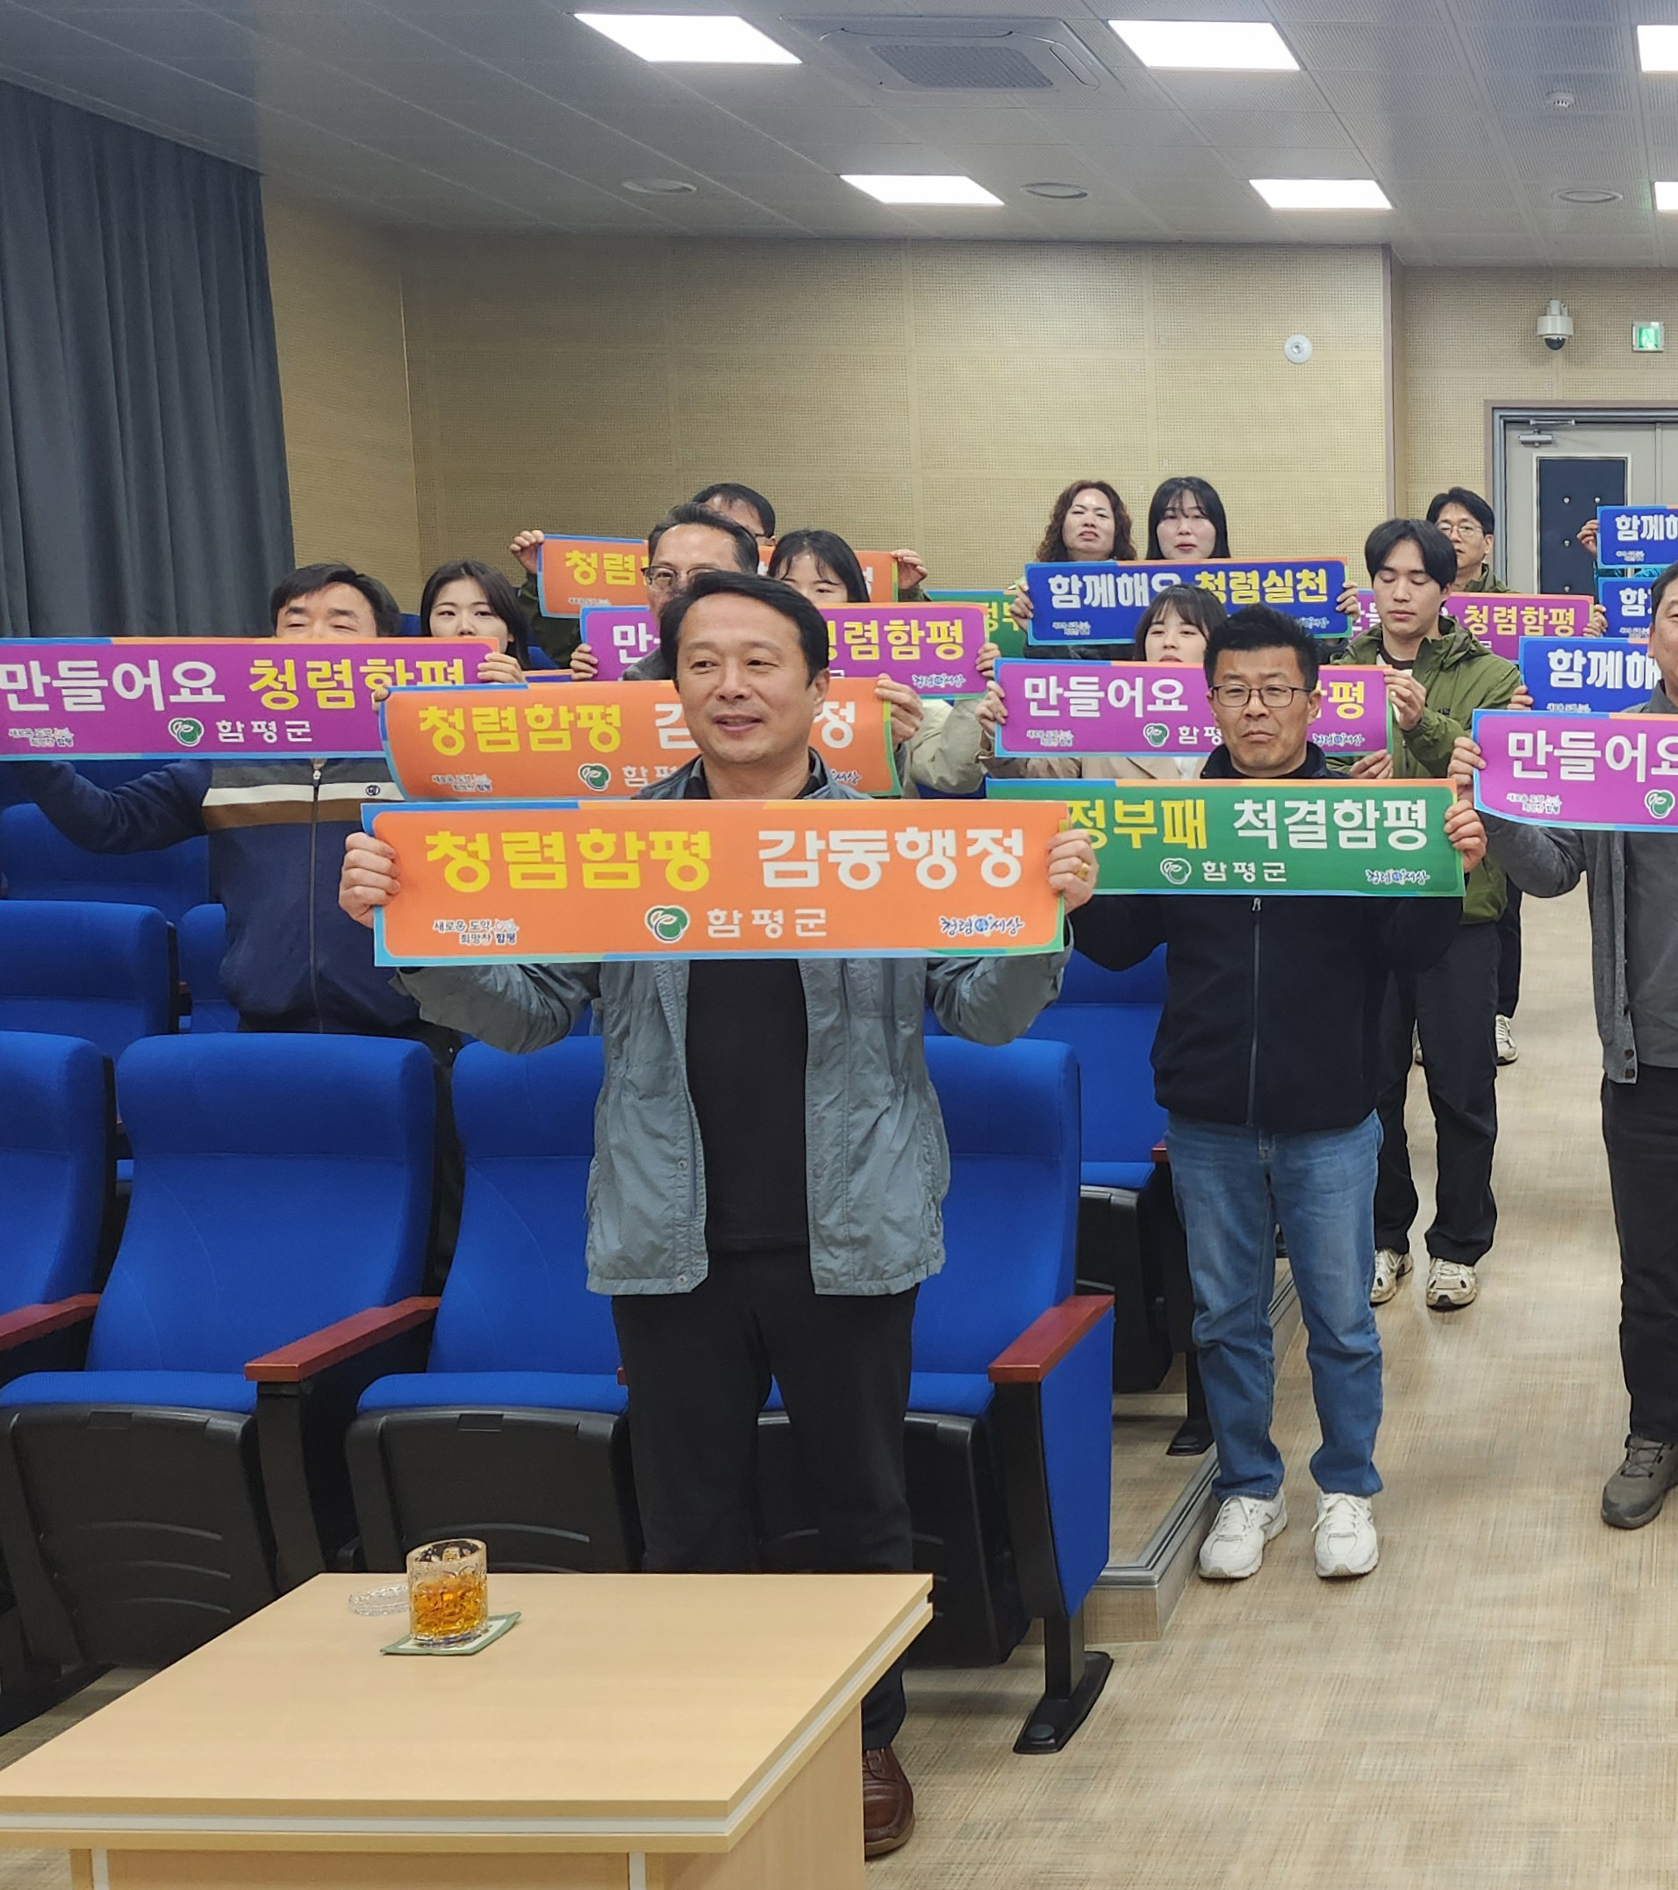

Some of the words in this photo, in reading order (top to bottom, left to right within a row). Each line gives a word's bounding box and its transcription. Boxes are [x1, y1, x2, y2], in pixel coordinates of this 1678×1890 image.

[827, 619, 965, 663] 렴함평
[1464, 605, 1575, 637] 청렴함평
[0, 658, 226, 712] 만들어요
[1547, 649, 1661, 690] 함께해
[1024, 676, 1188, 718] 만들어요
[215, 719, 313, 744] 함평군
[419, 701, 622, 757] 청렴함평
[1177, 724, 1223, 746] 함평
[1067, 799, 1208, 850] 정부패
[1232, 799, 1428, 852] 척결함평
[425, 828, 712, 893] 청렴함평
[758, 826, 1024, 890] 감동행정
[1201, 860, 1288, 884] 함평군
[706, 908, 828, 940] 함평군
